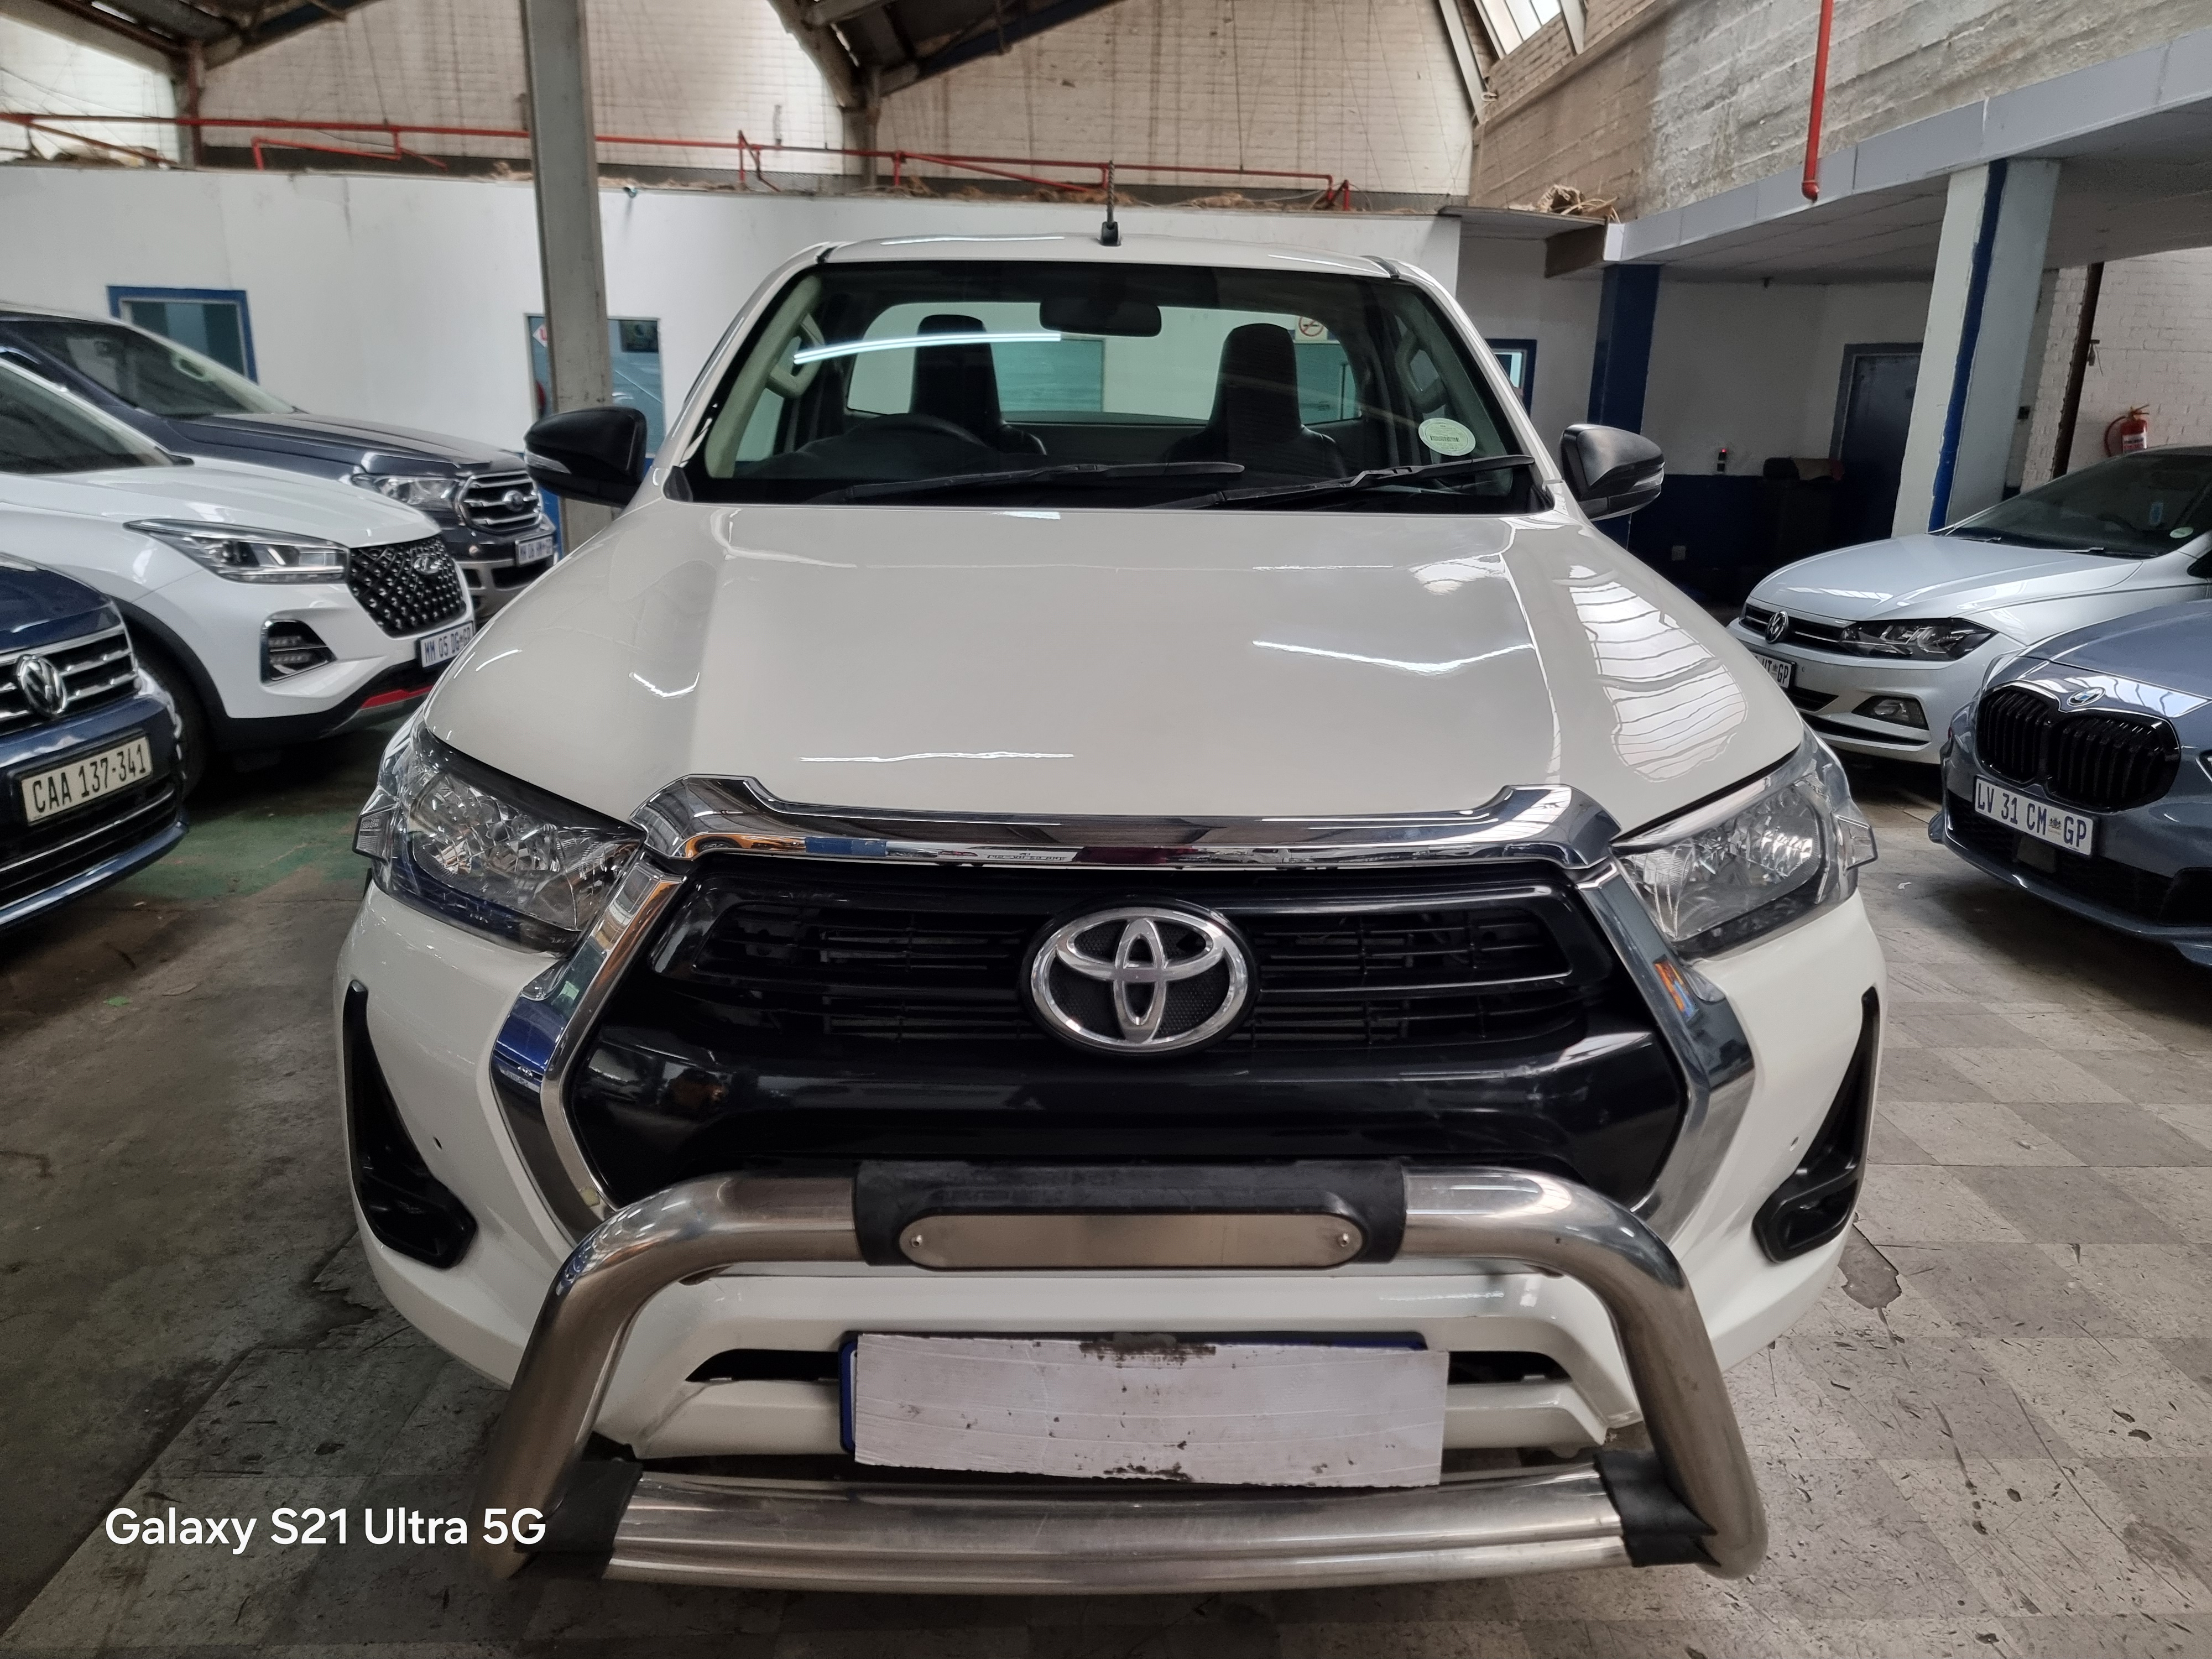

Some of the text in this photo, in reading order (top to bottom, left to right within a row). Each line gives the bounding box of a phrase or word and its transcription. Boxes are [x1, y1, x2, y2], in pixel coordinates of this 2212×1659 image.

[1777, 664, 1789, 684] GP
[33, 772, 72, 813] CAA
[1978, 783, 2086, 847] LV 31 CM GP
